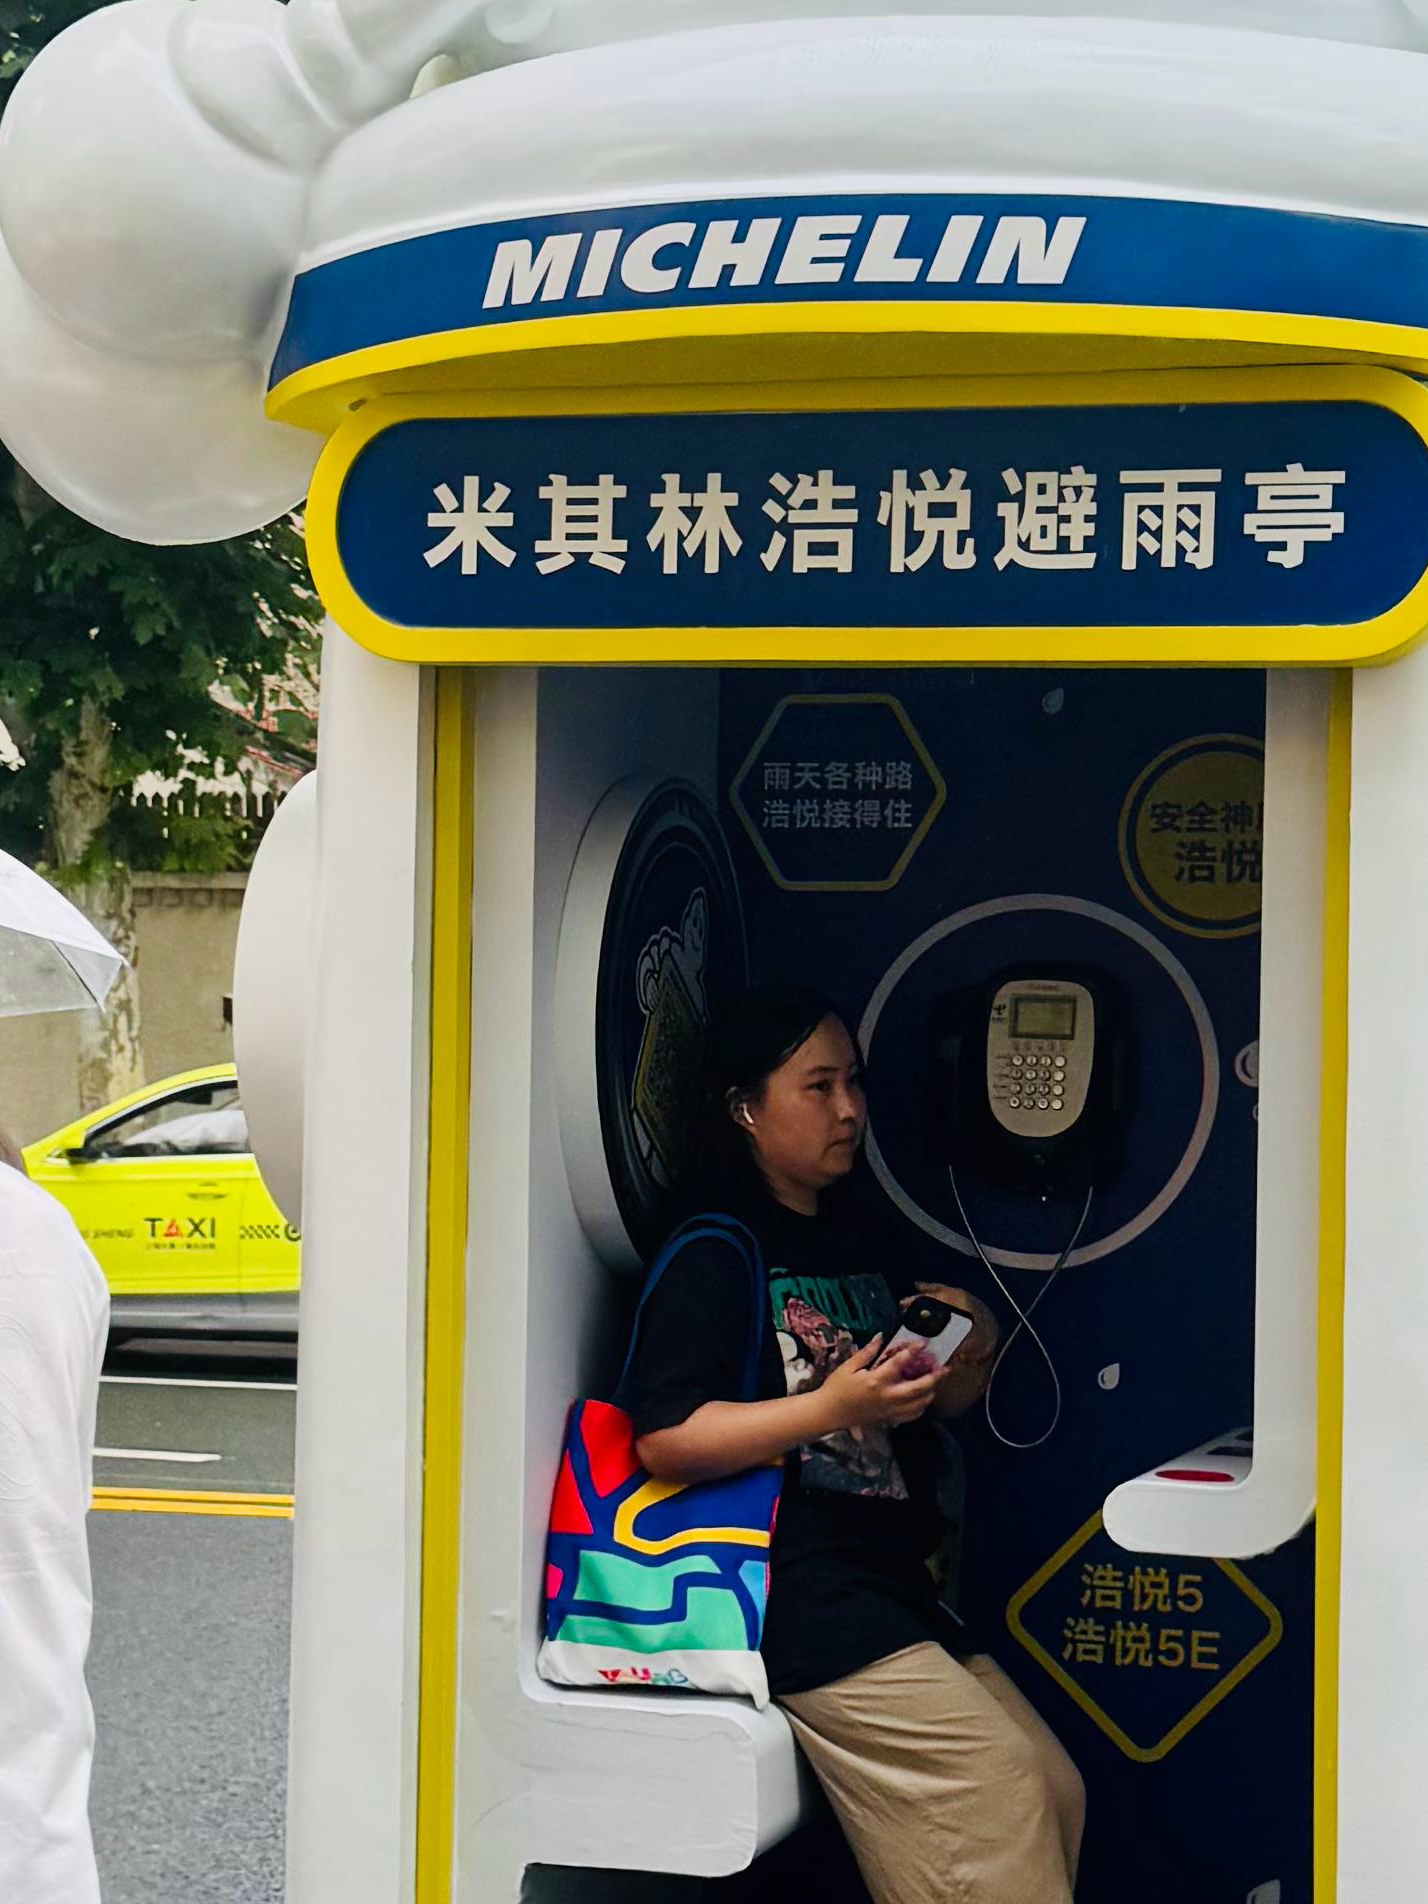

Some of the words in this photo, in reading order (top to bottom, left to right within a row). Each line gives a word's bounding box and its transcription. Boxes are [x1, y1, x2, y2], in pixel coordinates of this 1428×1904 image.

[482, 215, 1086, 307] MICHELIN
[424, 463, 1346, 575] 米其林浩悦避雨亭
[763, 761, 913, 791] 雨天各种路
[763, 799, 913, 829] 浩悦接得住
[1151, 800, 1263, 833] 安全神
[144, 1217, 216, 1238] TAXI
[1081, 1563, 1203, 1613] 浩悦5
[1063, 1618, 1220, 1671] 浩悦5E
